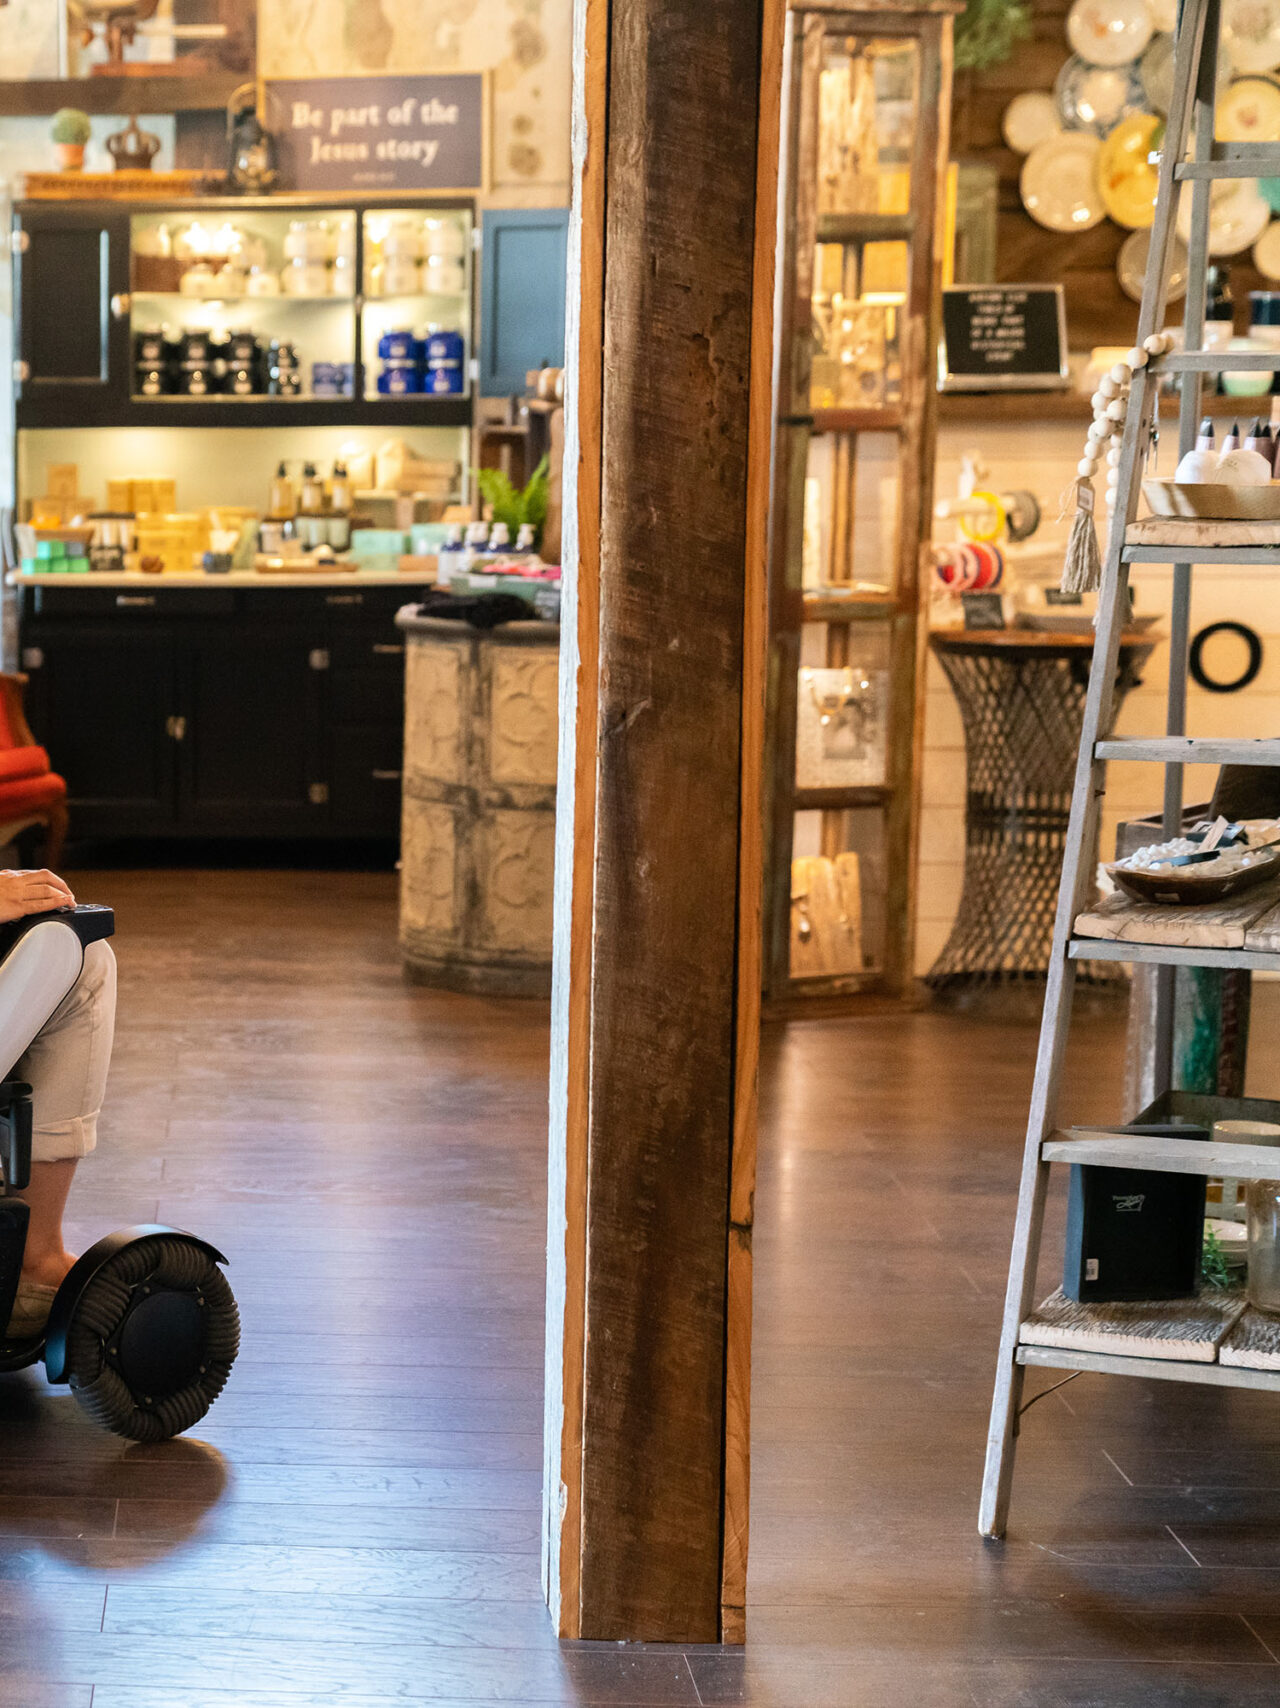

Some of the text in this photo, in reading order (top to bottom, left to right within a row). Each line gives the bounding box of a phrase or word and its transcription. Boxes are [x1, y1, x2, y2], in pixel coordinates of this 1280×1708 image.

[293, 97, 459, 135] Be part of the
[310, 135, 439, 168] Jesus story
